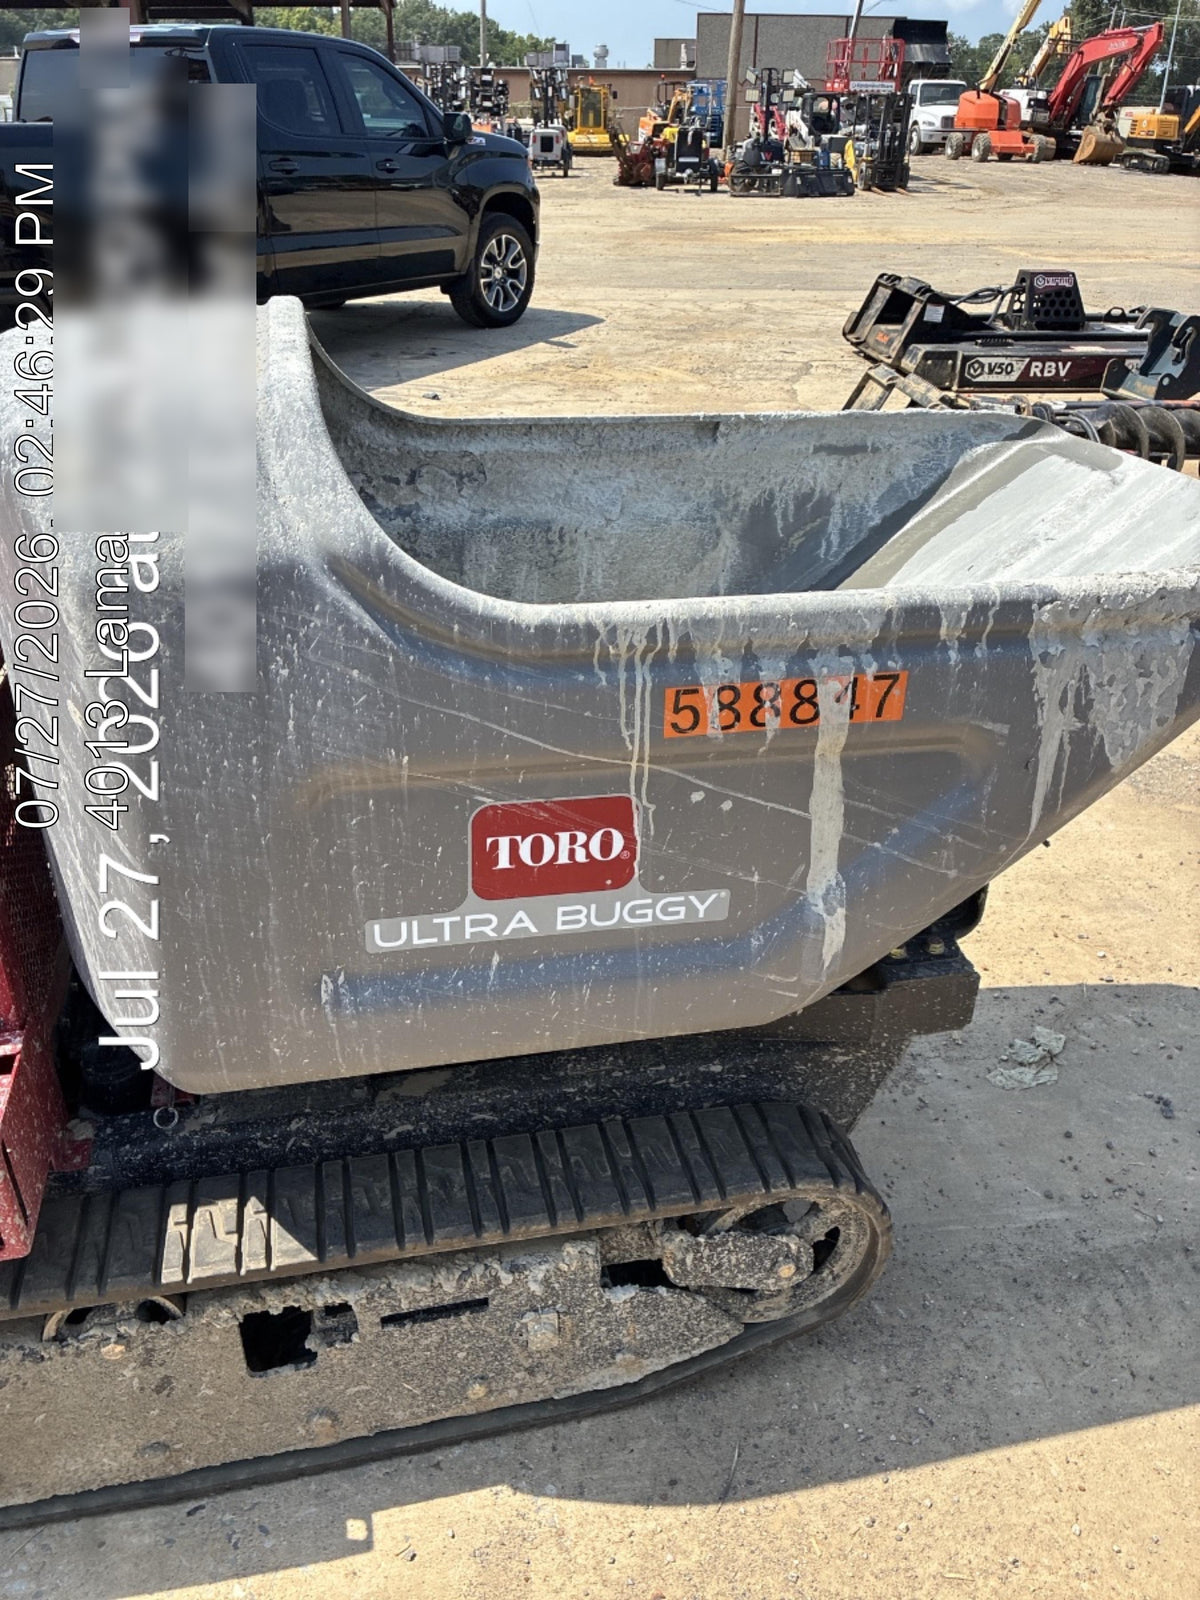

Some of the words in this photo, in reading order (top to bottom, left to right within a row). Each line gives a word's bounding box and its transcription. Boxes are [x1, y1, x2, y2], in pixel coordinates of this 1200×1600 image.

[987, 362, 1015, 375] V50
[1029, 361, 1072, 377] RBV
[486, 827, 625, 870] TORO
[373, 909, 539, 948] ULTRA
[556, 893, 718, 930] BUGGY
